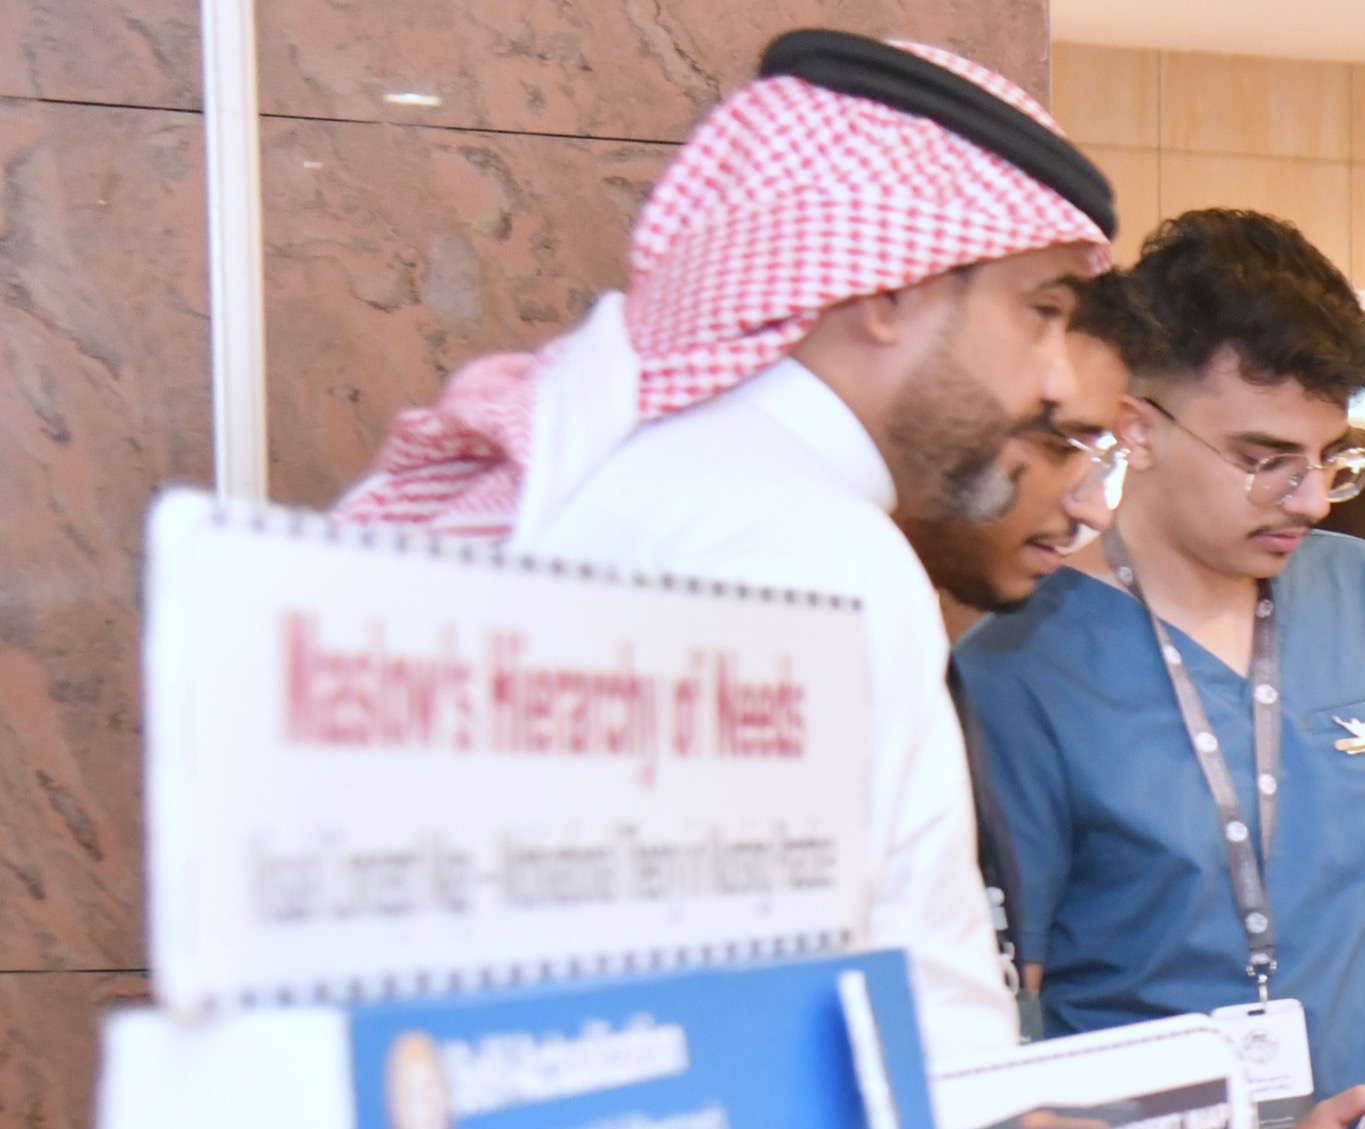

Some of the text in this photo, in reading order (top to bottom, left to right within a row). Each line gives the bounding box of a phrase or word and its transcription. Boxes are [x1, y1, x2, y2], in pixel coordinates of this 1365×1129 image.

[486, 629, 659, 789] Hierarchy
[673, 647, 707, 758] of
[712, 650, 808, 759] Needs
